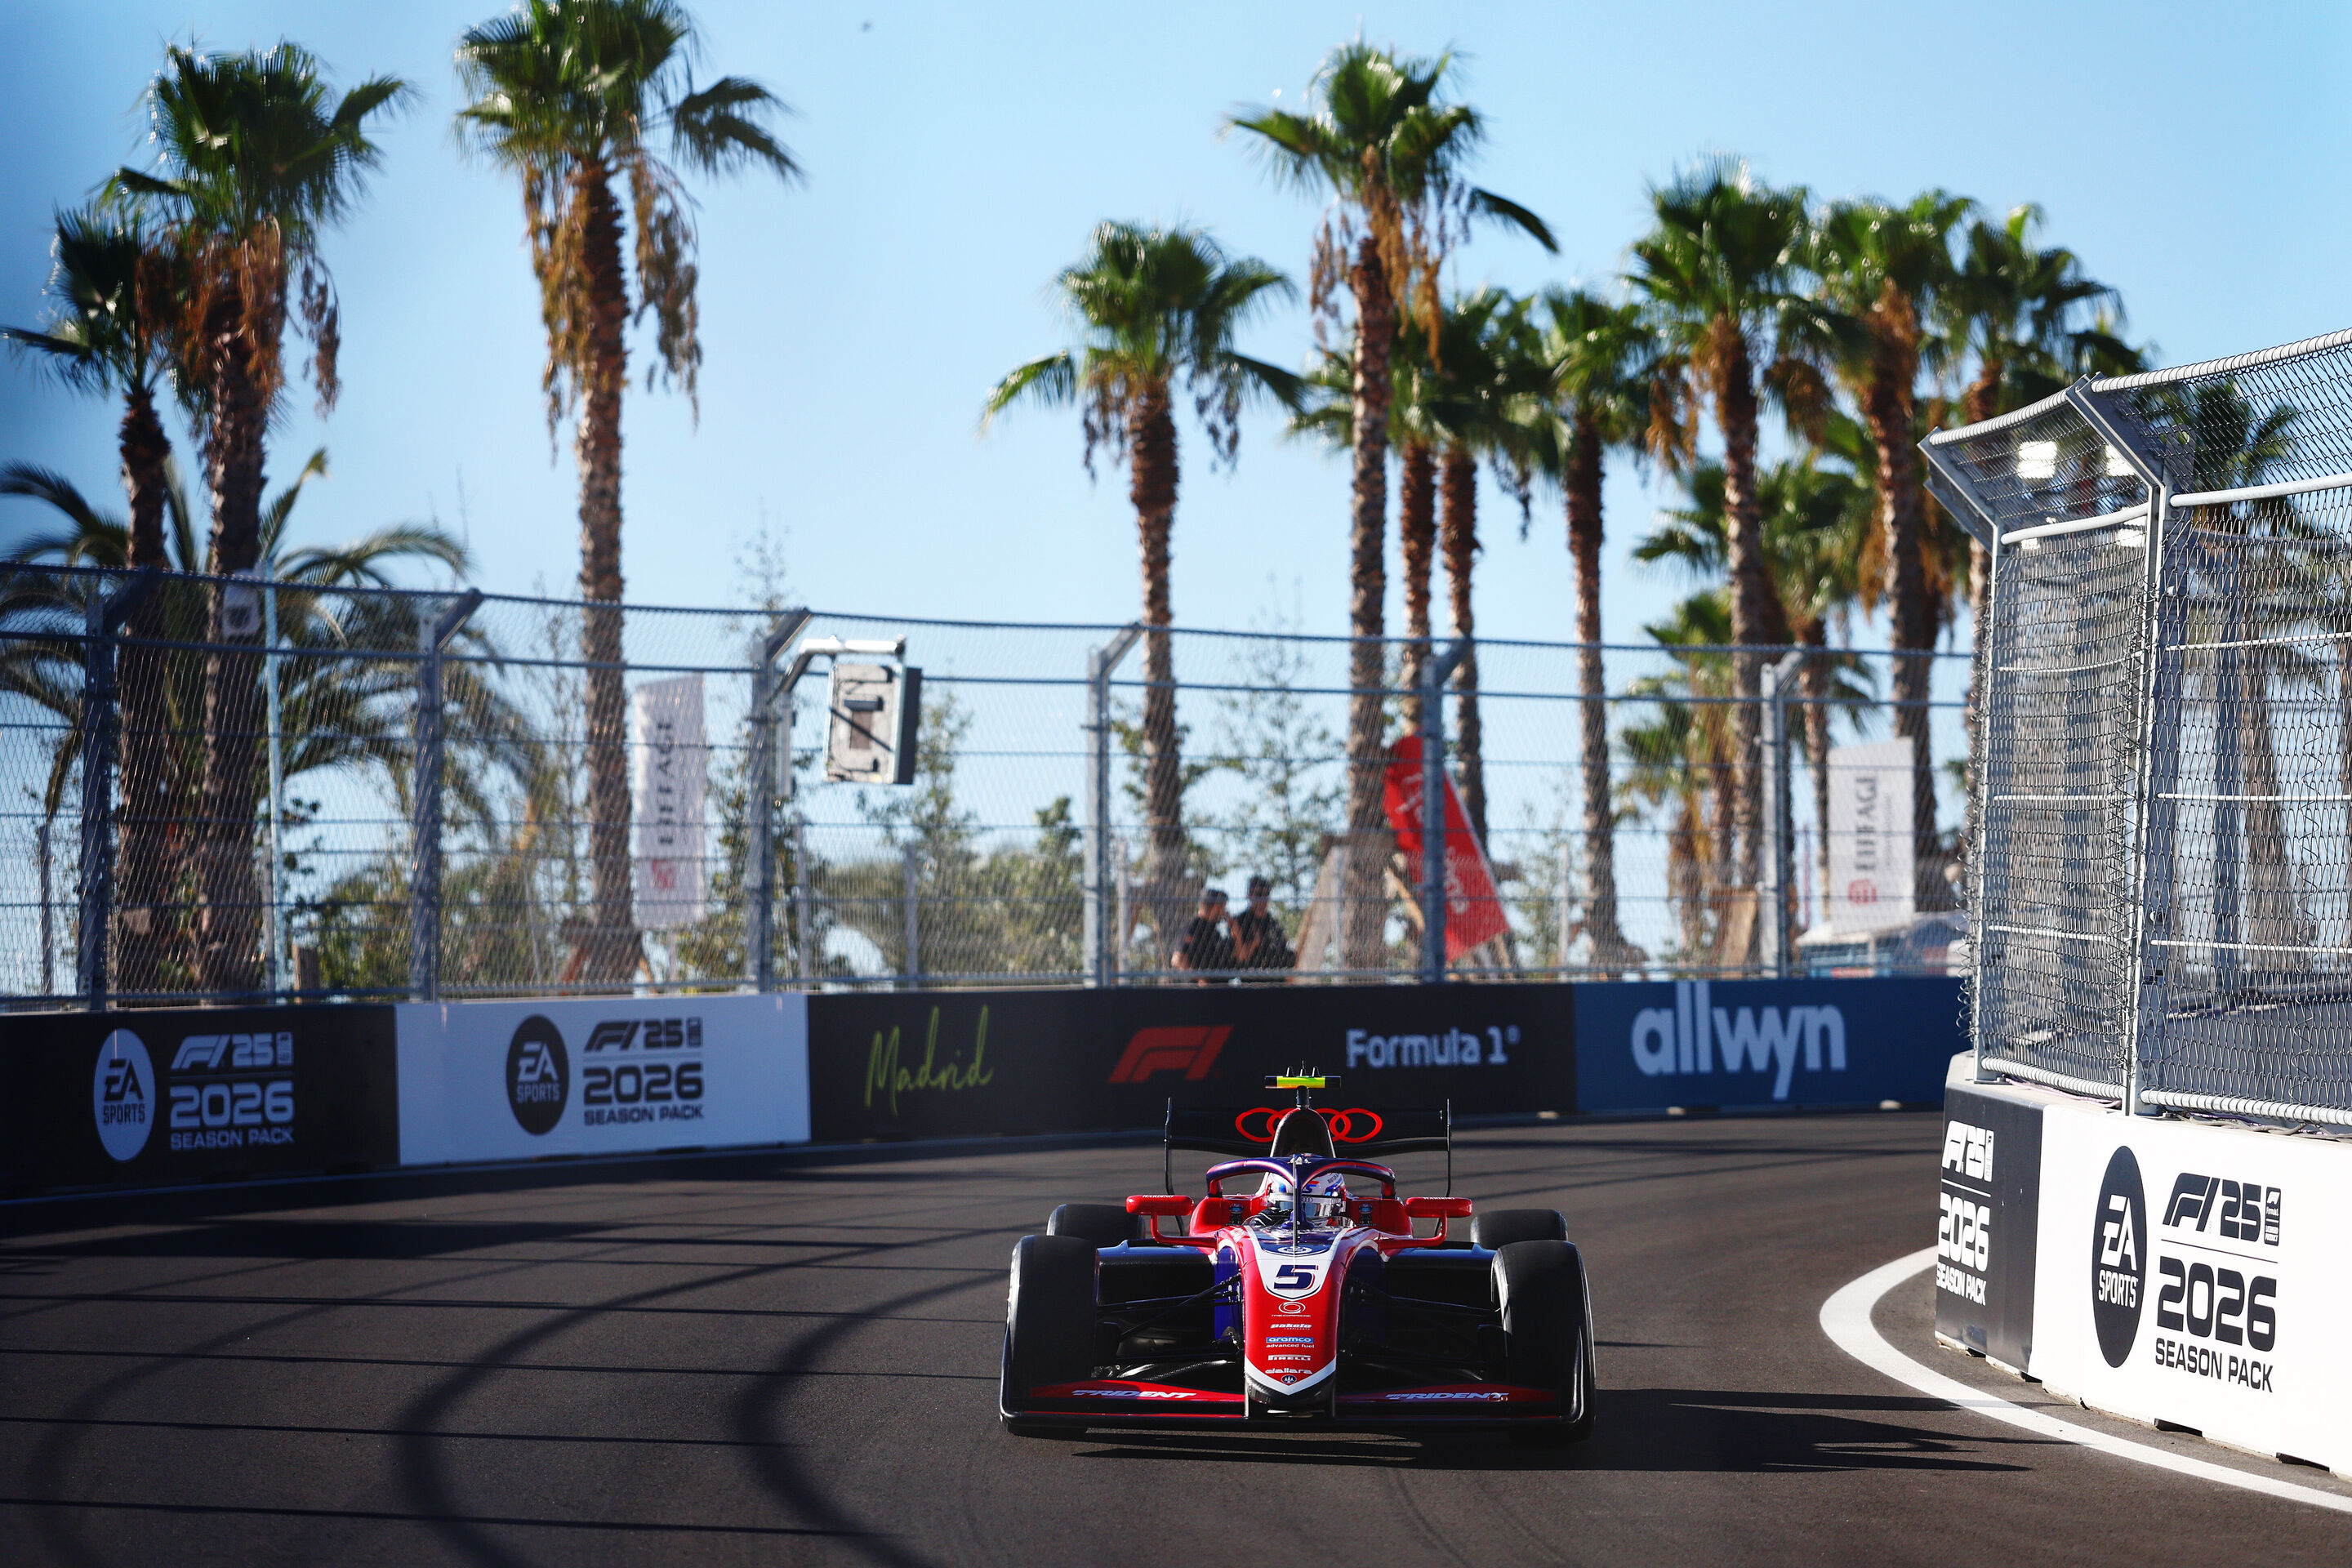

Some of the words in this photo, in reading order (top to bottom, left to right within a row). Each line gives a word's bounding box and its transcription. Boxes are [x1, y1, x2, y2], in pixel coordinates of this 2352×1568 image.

[232, 1032, 274, 1067] 25
[644, 1018, 684, 1049] 25
[1108, 1025, 1233, 1083] F1
[1347, 1027, 1481, 1068] Formula
[1631, 980, 1846, 1101] allwyn
[104, 1058, 144, 1101] EA
[517, 1040, 559, 1081] EA
[864, 1004, 994, 1116] Madrid
[170, 1080, 295, 1129] 2026
[516, 1082, 560, 1103] SPORTS
[583, 1062, 703, 1106] 2026
[104, 1103, 145, 1125] SPORTS
[584, 1107, 653, 1126] SEASON
[659, 1103, 704, 1121] PACK
[170, 1129, 243, 1152] SEASON
[248, 1126, 295, 1147] PACK
[1966, 1125, 1986, 1179] 25
[2162, 1172, 2221, 1232] F1
[2220, 1179, 2261, 1242] 25
[1938, 1192, 1990, 1272] 2026
[2100, 1194, 2137, 1271] EA
[1273, 1264, 1319, 1290] 5
[1936, 1261, 1966, 1297] SEASON
[1965, 1273, 1987, 1307] PACK
[2098, 1269, 2136, 1308] SPORTS
[2156, 1255, 2277, 1352] 2026
[2154, 1337, 2222, 1382] SEASON
[2228, 1356, 2274, 1393] PACK
[1071, 1390, 1196, 1399] TRIDENT
